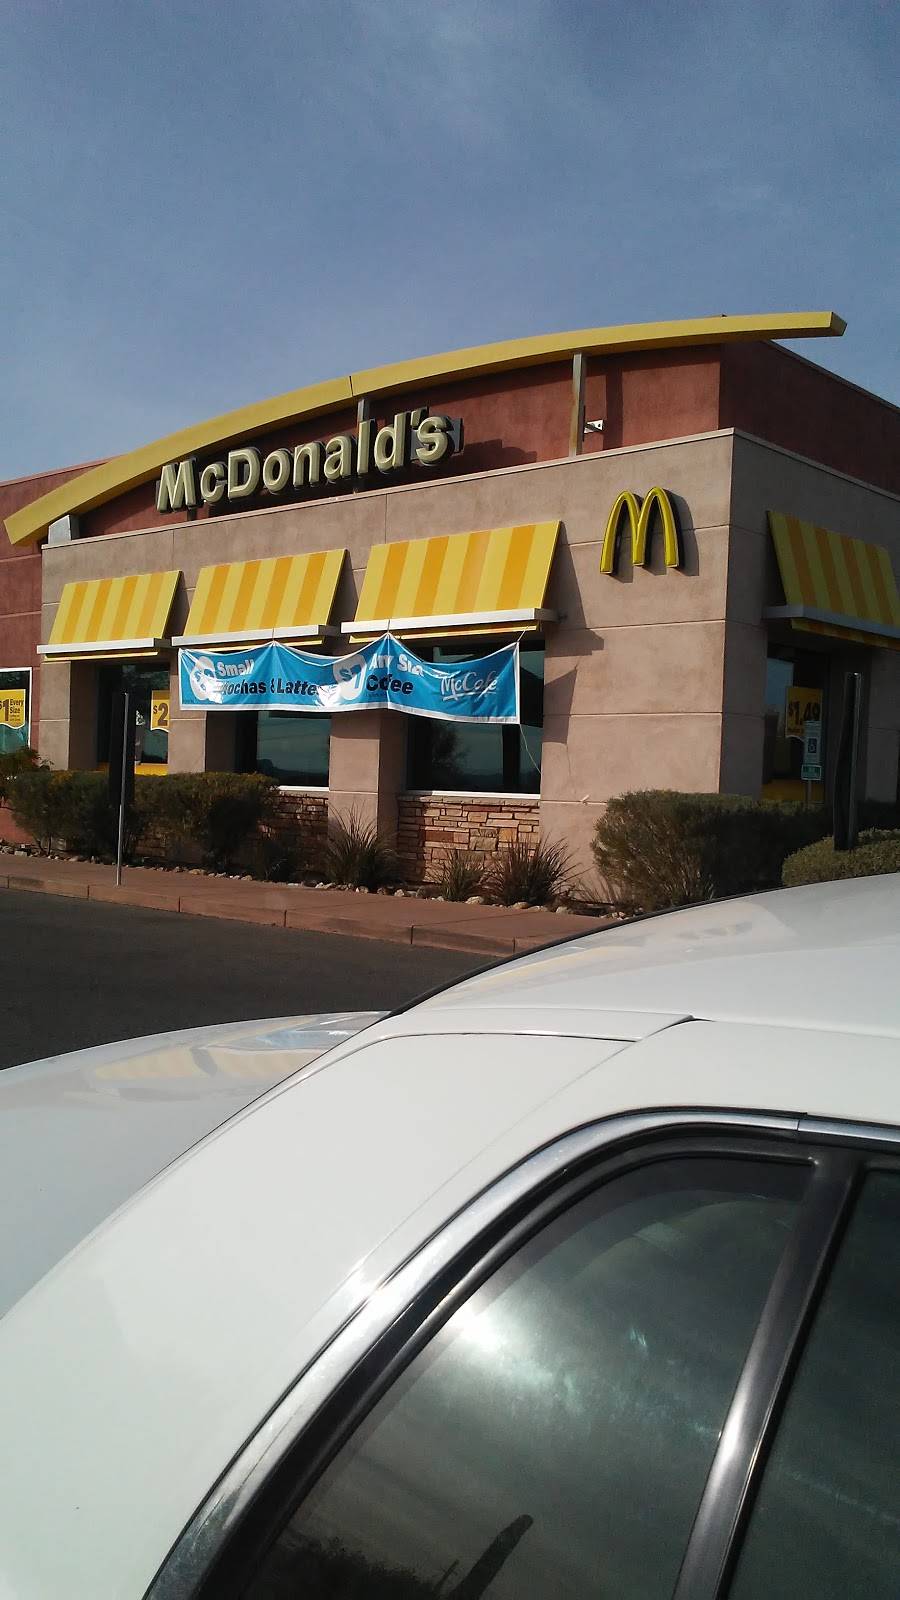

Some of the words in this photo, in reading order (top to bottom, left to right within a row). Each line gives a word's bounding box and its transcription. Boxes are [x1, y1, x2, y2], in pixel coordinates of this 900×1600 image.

[156, 408, 452, 512] McDonald's
[216, 659, 255, 677] Small
[276, 678, 319, 696] Latte
